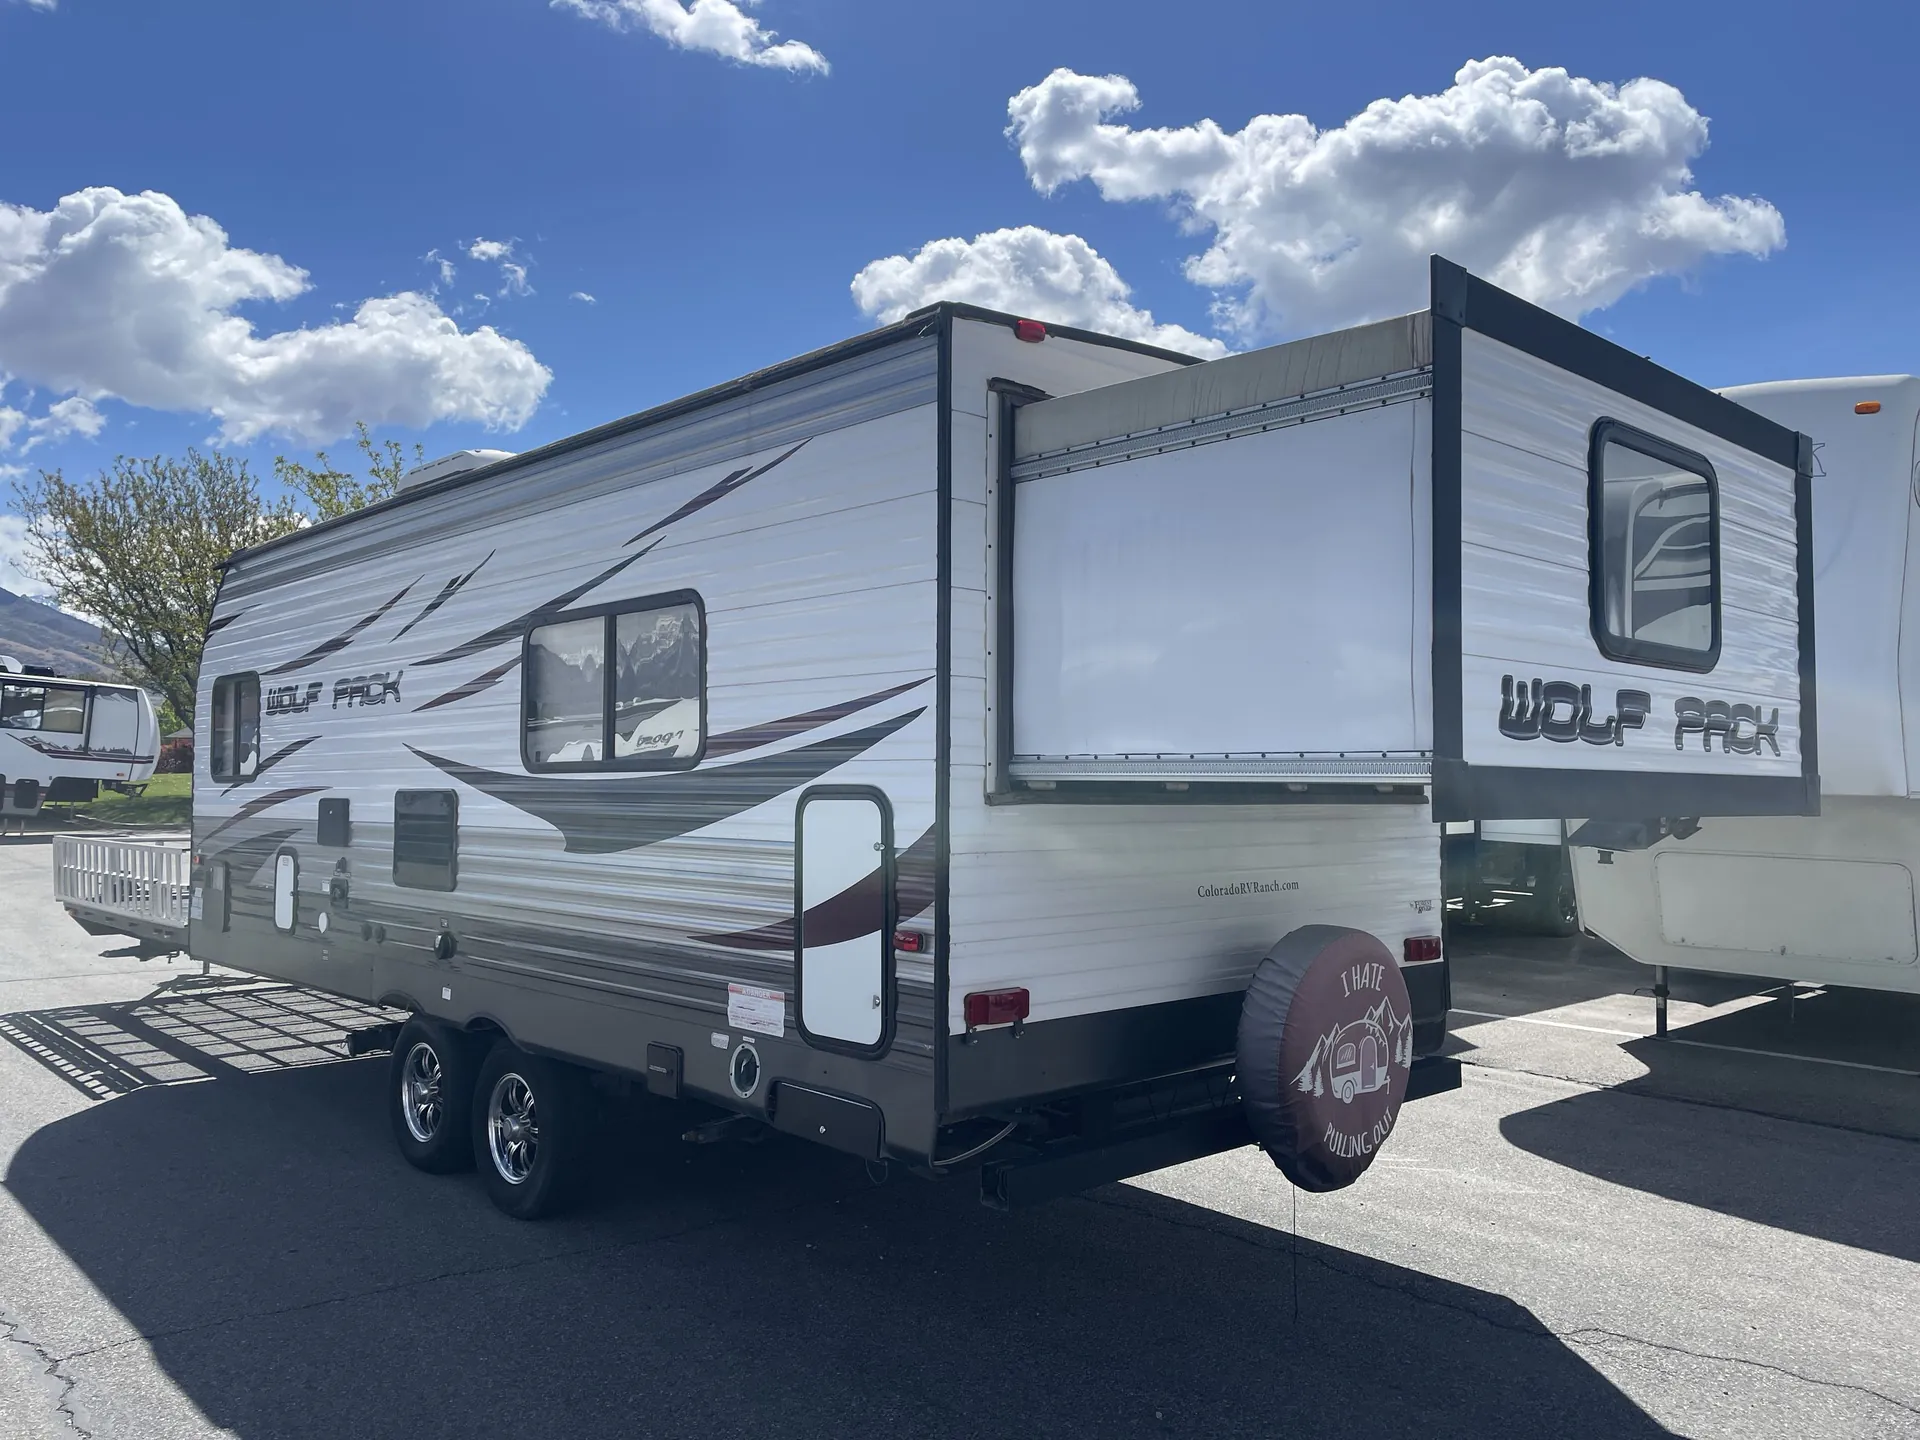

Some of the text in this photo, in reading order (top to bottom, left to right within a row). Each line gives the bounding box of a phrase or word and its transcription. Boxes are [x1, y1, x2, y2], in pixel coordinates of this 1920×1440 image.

[266, 669, 404, 716] WOLF PACK
[1499, 674, 1781, 757] WOLF PACK
[1197, 880, 1300, 898] ColoradoRVRanch.com
[1340, 962, 1386, 998] I HATE
[1323, 1105, 1393, 1158] PULLING OUT
